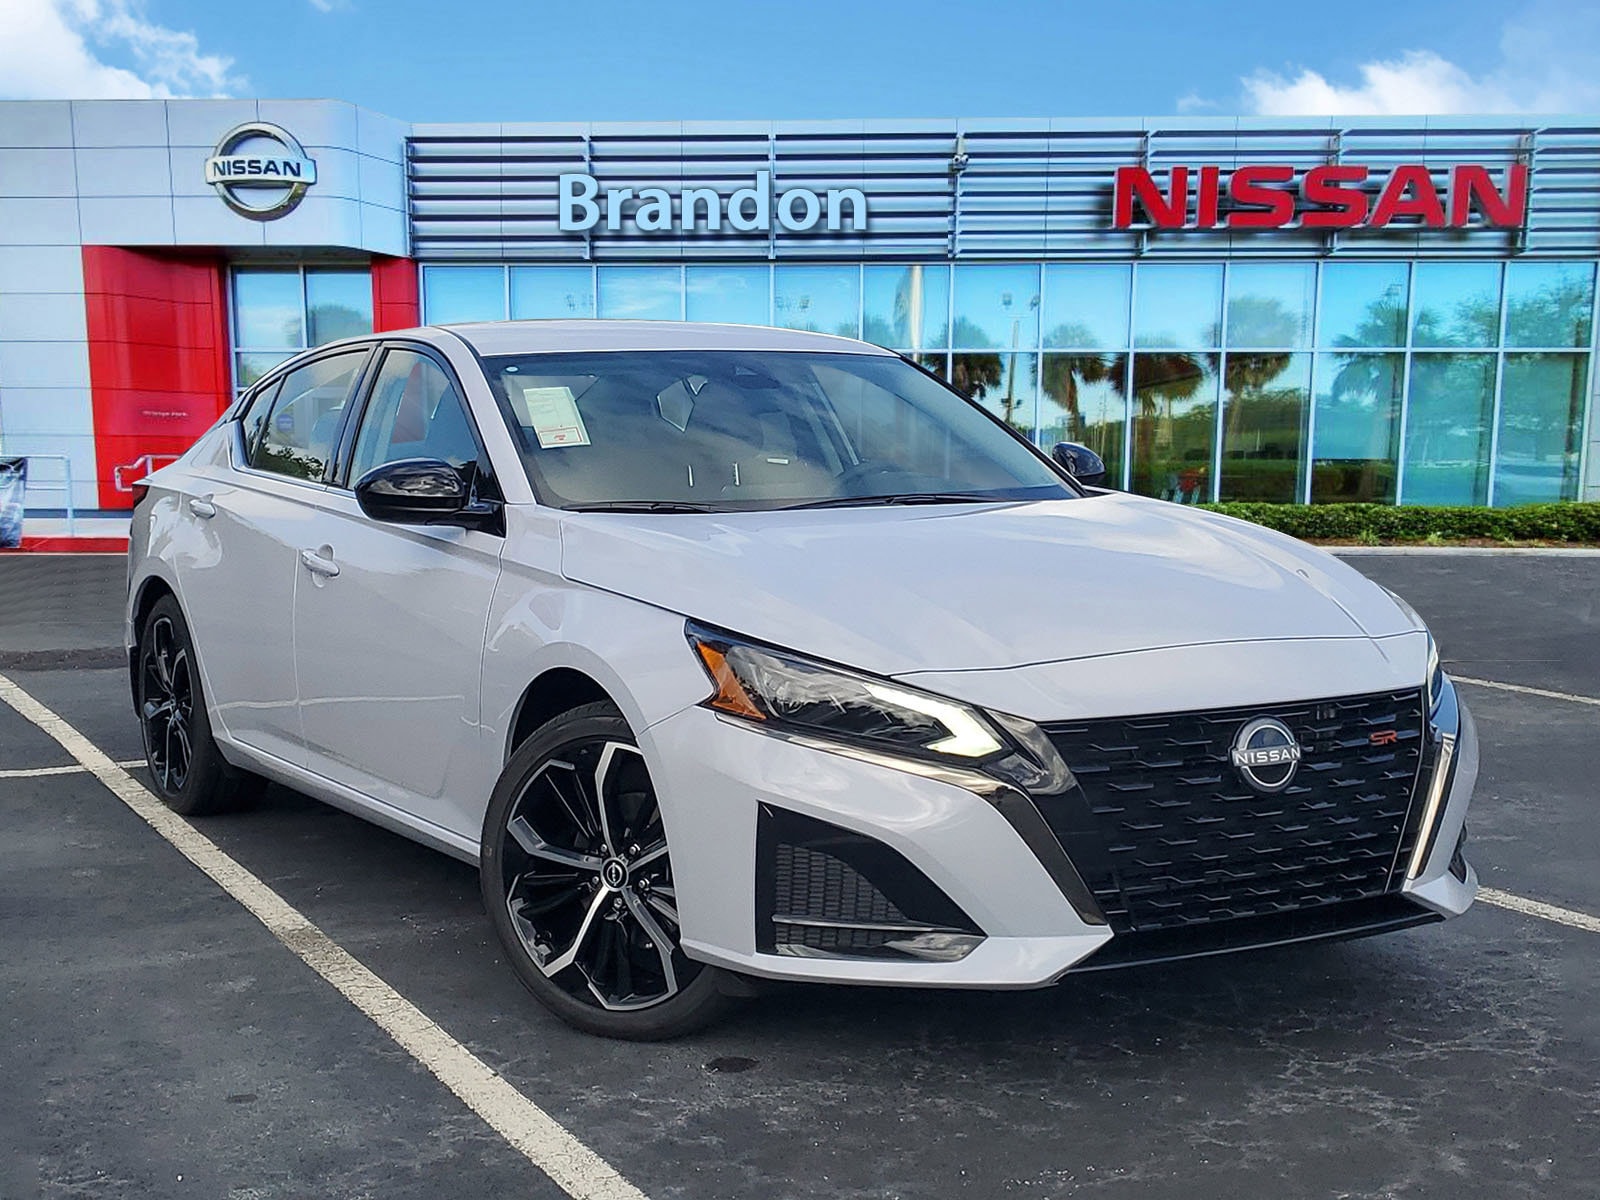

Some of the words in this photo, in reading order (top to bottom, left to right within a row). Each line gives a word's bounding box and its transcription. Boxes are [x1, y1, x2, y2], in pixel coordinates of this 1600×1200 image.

[213, 160, 301, 177] NISSAN
[559, 171, 867, 231] Brandon
[1113, 165, 1528, 229] NISSAN
[1370, 730, 1397, 745] SR
[1235, 747, 1300, 765] NISSAN
